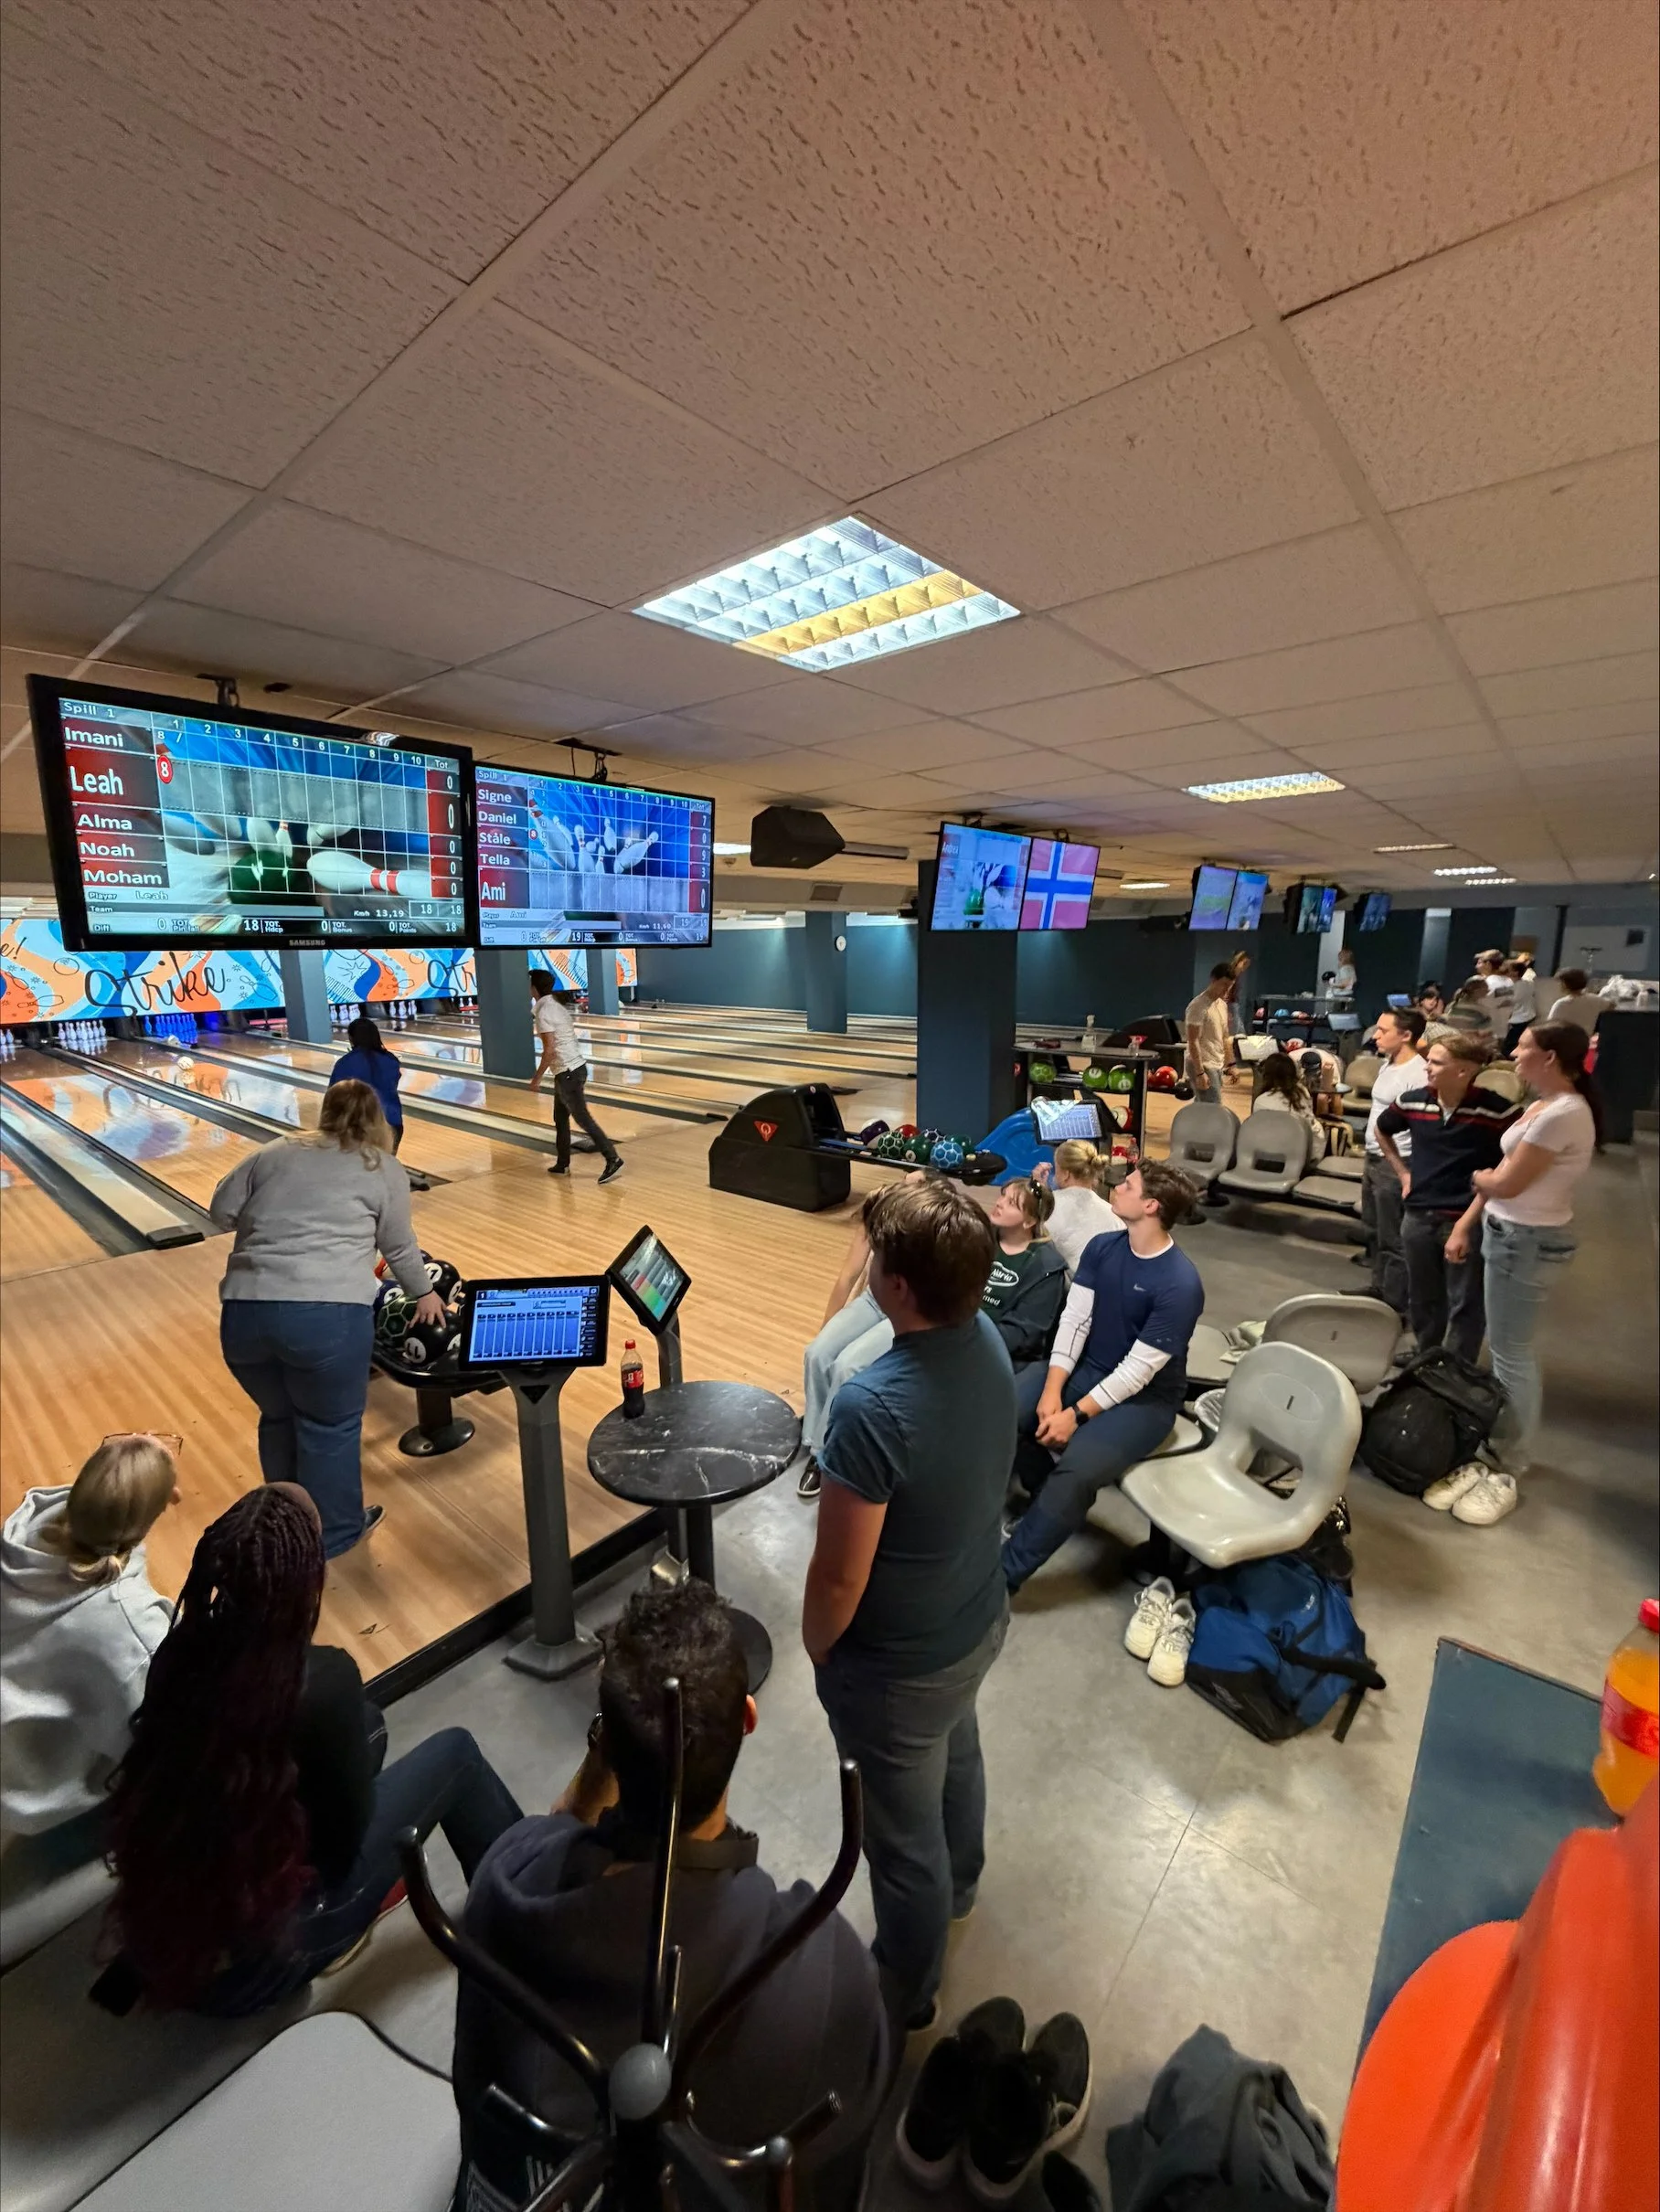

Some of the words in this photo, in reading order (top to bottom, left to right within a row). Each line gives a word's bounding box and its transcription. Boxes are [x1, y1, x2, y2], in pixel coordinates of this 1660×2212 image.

[64, 702, 96, 715] Spill
[107, 708, 115, 718] 1
[64, 727, 123, 748] Imani
[157, 731, 165, 739] 8
[173, 718, 179, 728] 1
[204, 724, 211, 734] 2
[234, 728, 241, 739] 3
[263, 733, 271, 743] 4
[292, 738, 299, 747] 5
[318, 741, 325, 751] 6
[344, 745, 351, 755] 7
[368, 749, 376, 759] 8
[393, 752, 399, 761] 9
[410, 756, 421, 765] 10
[159, 760, 170, 778] 8
[478, 770, 497, 780] Spill
[69, 765, 123, 795] Leah
[446, 775, 453, 790] 0
[477, 789, 512, 803] Signe
[77, 814, 133, 830] Alma
[447, 803, 454, 830] 0
[478, 811, 517, 824] Daniel
[479, 832, 511, 845] Ståle
[80, 841, 135, 857] Noah
[449, 840, 455, 854] 0
[480, 854, 510, 866] Tella
[450, 861, 456, 875] 0
[83, 869, 162, 885] Moham
[89, 891, 117, 900] Player
[135, 890, 168, 900] Leah
[451, 882, 457, 896] 0
[481, 881, 506, 901] Ami
[376, 909, 404, 918] 13,19
[420, 904, 432, 914] 18
[451, 905, 462, 915] 18
[157, 919, 165, 931] 0
[243, 920, 259, 931] 18
[321, 920, 328, 931] 0
[388, 921, 395, 931] 0
[445, 922, 457, 932] 18
[571, 932, 581, 941] 19
[85, 951, 226, 1016] Strike
